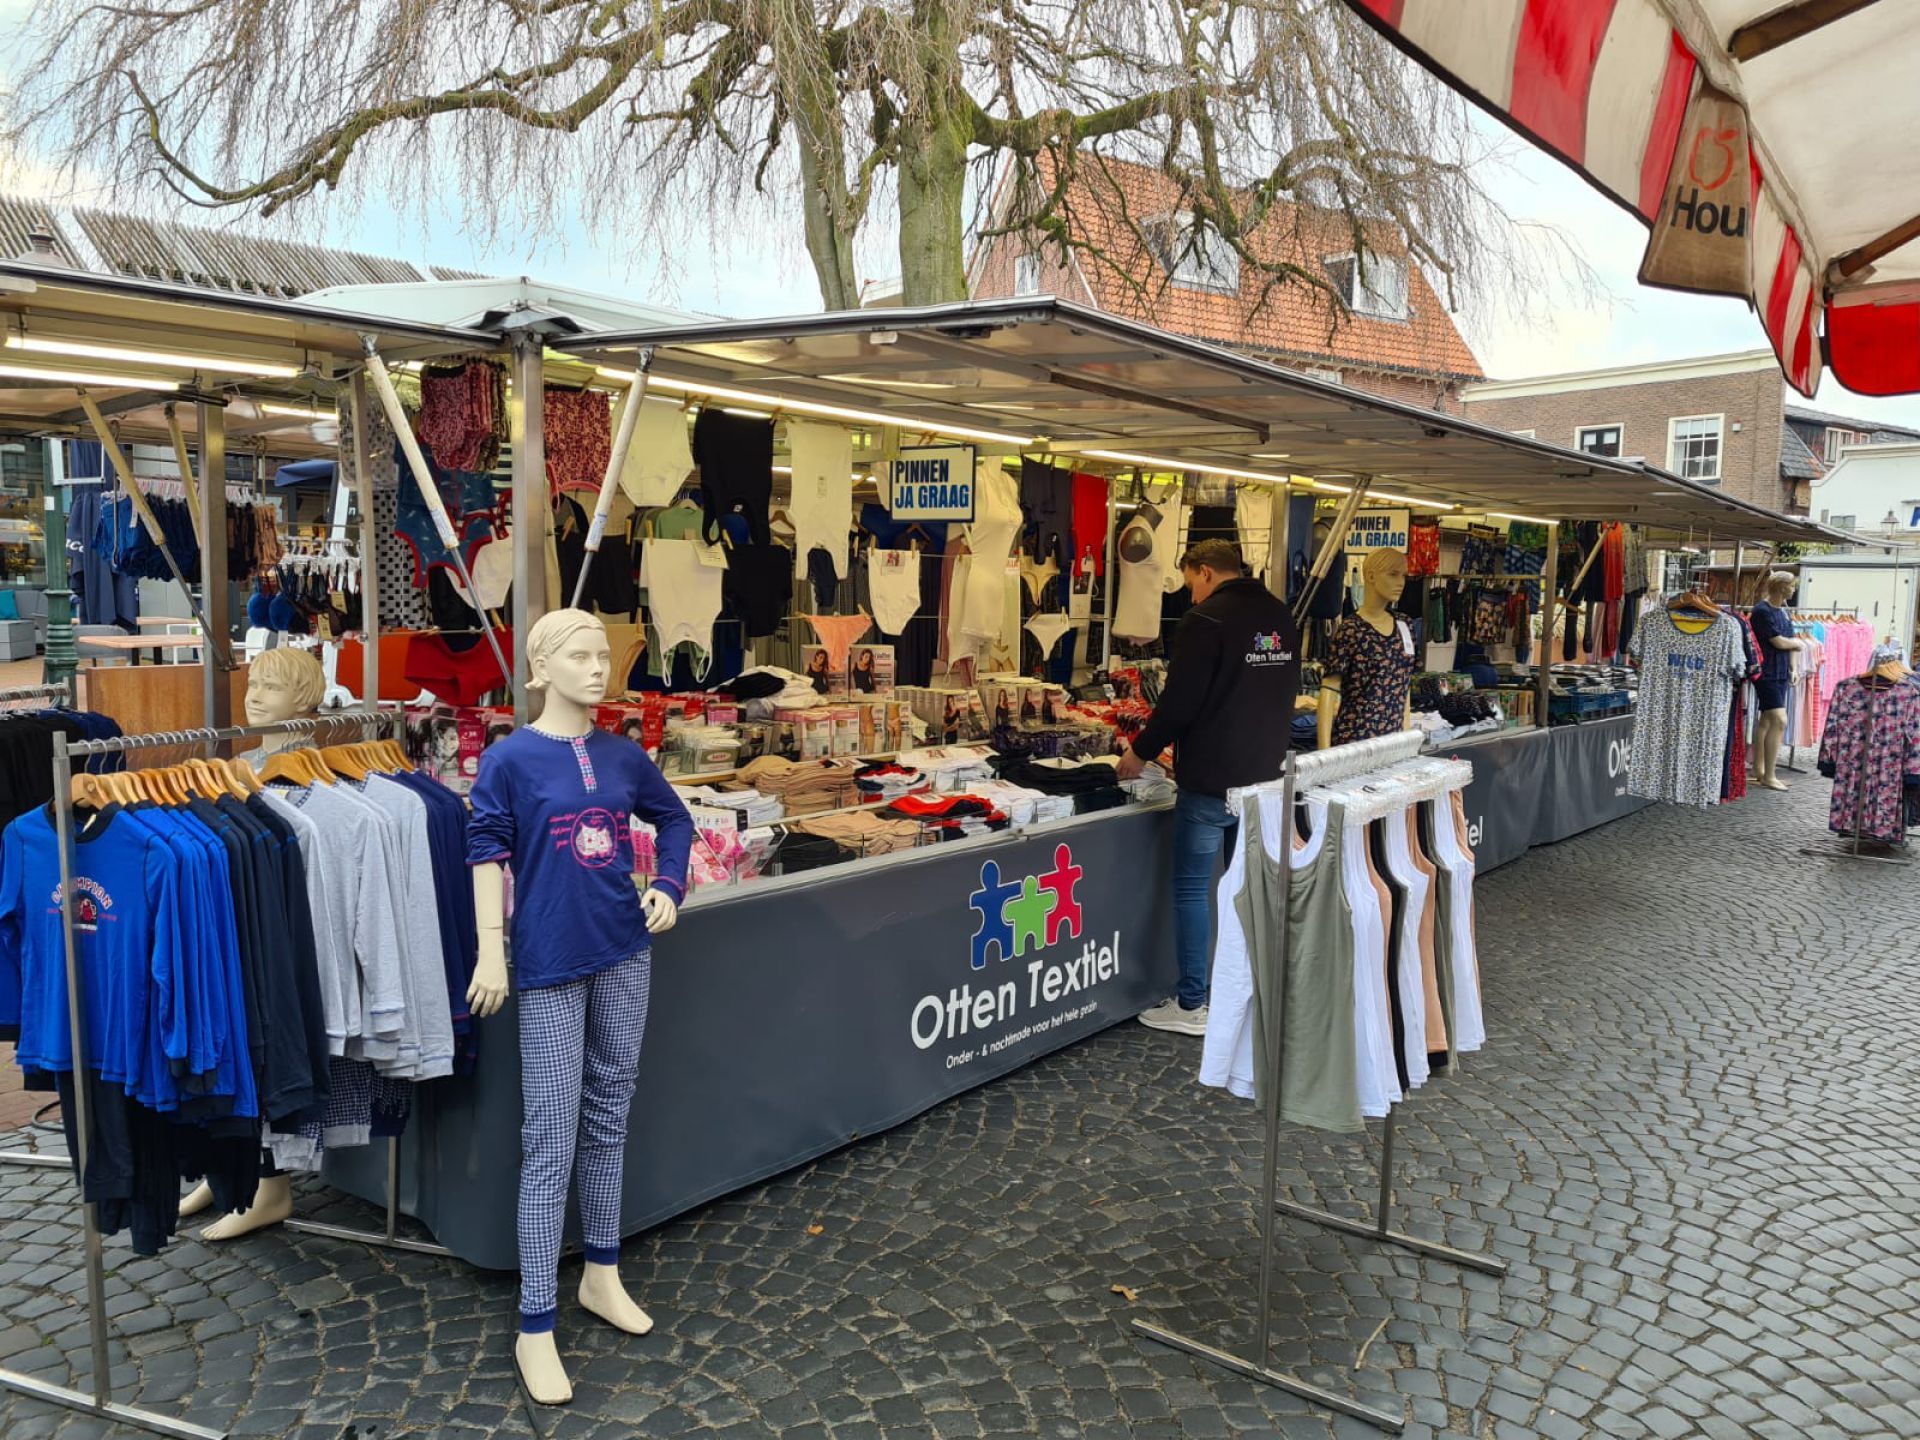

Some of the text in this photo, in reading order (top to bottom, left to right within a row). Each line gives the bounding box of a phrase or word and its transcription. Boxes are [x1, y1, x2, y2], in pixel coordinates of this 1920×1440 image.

[895, 459, 949, 484] PINNEN
[895, 485, 969, 508] JA GRAAG
[1347, 532, 1405, 547] JA GRAAG
[51, 877, 113, 910] CMPION
[911, 930, 1120, 1050] Otten Textiel
[946, 1050, 974, 1069] Onder
[990, 1025, 1032, 1054] nachtmode
[1032, 1020, 1051, 1034] voor
[1051, 1012, 1064, 1028] het
[1064, 1007, 1079, 1023] hele
